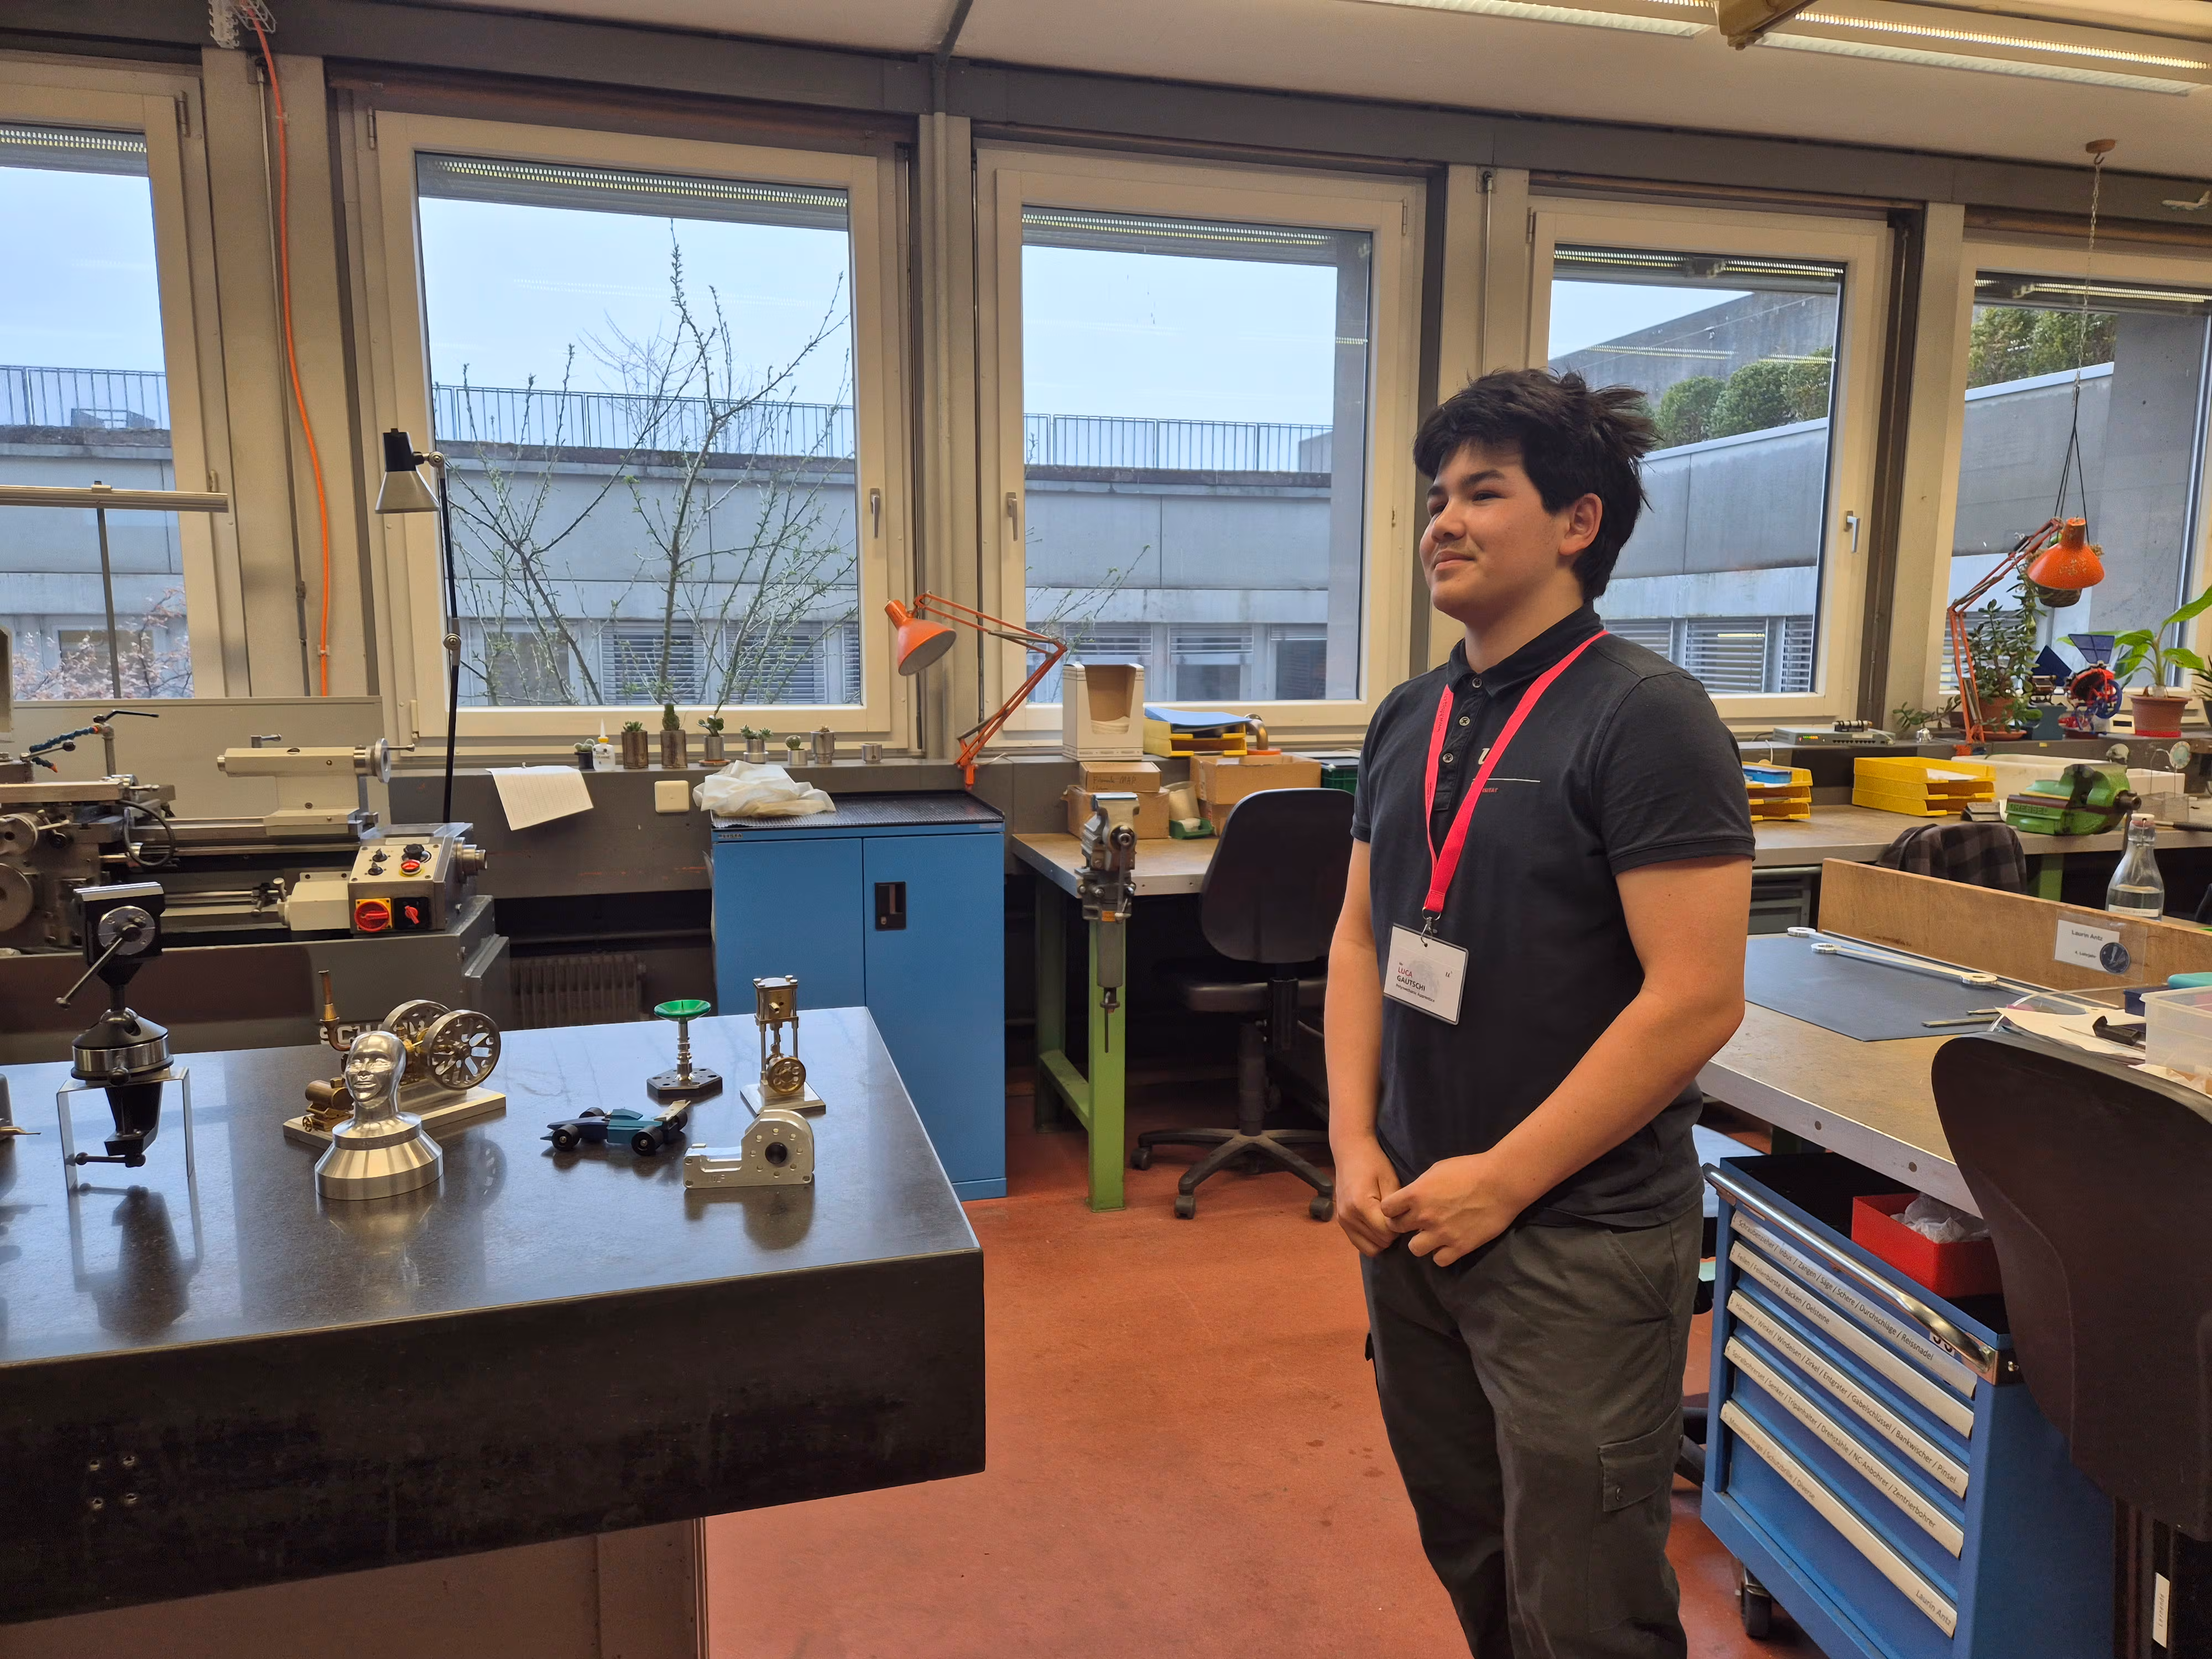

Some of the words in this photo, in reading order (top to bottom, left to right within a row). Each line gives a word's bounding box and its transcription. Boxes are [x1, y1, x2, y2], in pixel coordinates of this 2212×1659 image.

[2071, 929, 2089, 938] Laurin
[1397, 967, 1413, 978] LUCA
[1397, 975, 1426, 992] GAUTSCHI
[1738, 1253, 1750, 1267] Feilen
[1754, 1264, 1781, 1288] Feilenbürste
[1785, 1287, 1802, 1305] Backen
[1806, 1302, 1830, 1324] Oelsteine
[1738, 1220, 1775, 1249] Schraubenzieher
[1779, 1248, 1792, 1261] Inbus
[1798, 1261, 1817, 1279] Zangen
[1820, 1277, 1833, 1290] Säge
[1837, 1288, 1855, 1306] Schere
[1859, 1304, 1897, 1335] Durchschläge
[1901, 1333, 1933, 1361] Reissnadel
[1735, 1303, 1755, 1321] Hämmer
[1758, 1319, 1774, 1337] Winkel
[1777, 1335, 1802, 1359] Windeisen
[1804, 1357, 1819, 1373] Zirkel
[1823, 1372, 1847, 1395] Entgrater
[1851, 1395, 1892, 1431] Gabelschlüssel
[1896, 1430, 1933, 1465] Bankwischer
[1937, 1465, 1957, 1484] Pinsel
[1768, 1380, 1784, 1397] Senker
[1821, 1425, 1849, 1453] Drehstähle
[1853, 1453, 1888, 1487] NC-Anbohrer
[1892, 1488, 1936, 1528] Zentrierbohrer
[1797, 1479, 1815, 1500] Diverse
[1916, 1589, 1936, 1611] Laurin
[1937, 1608, 1952, 1626] Antz
